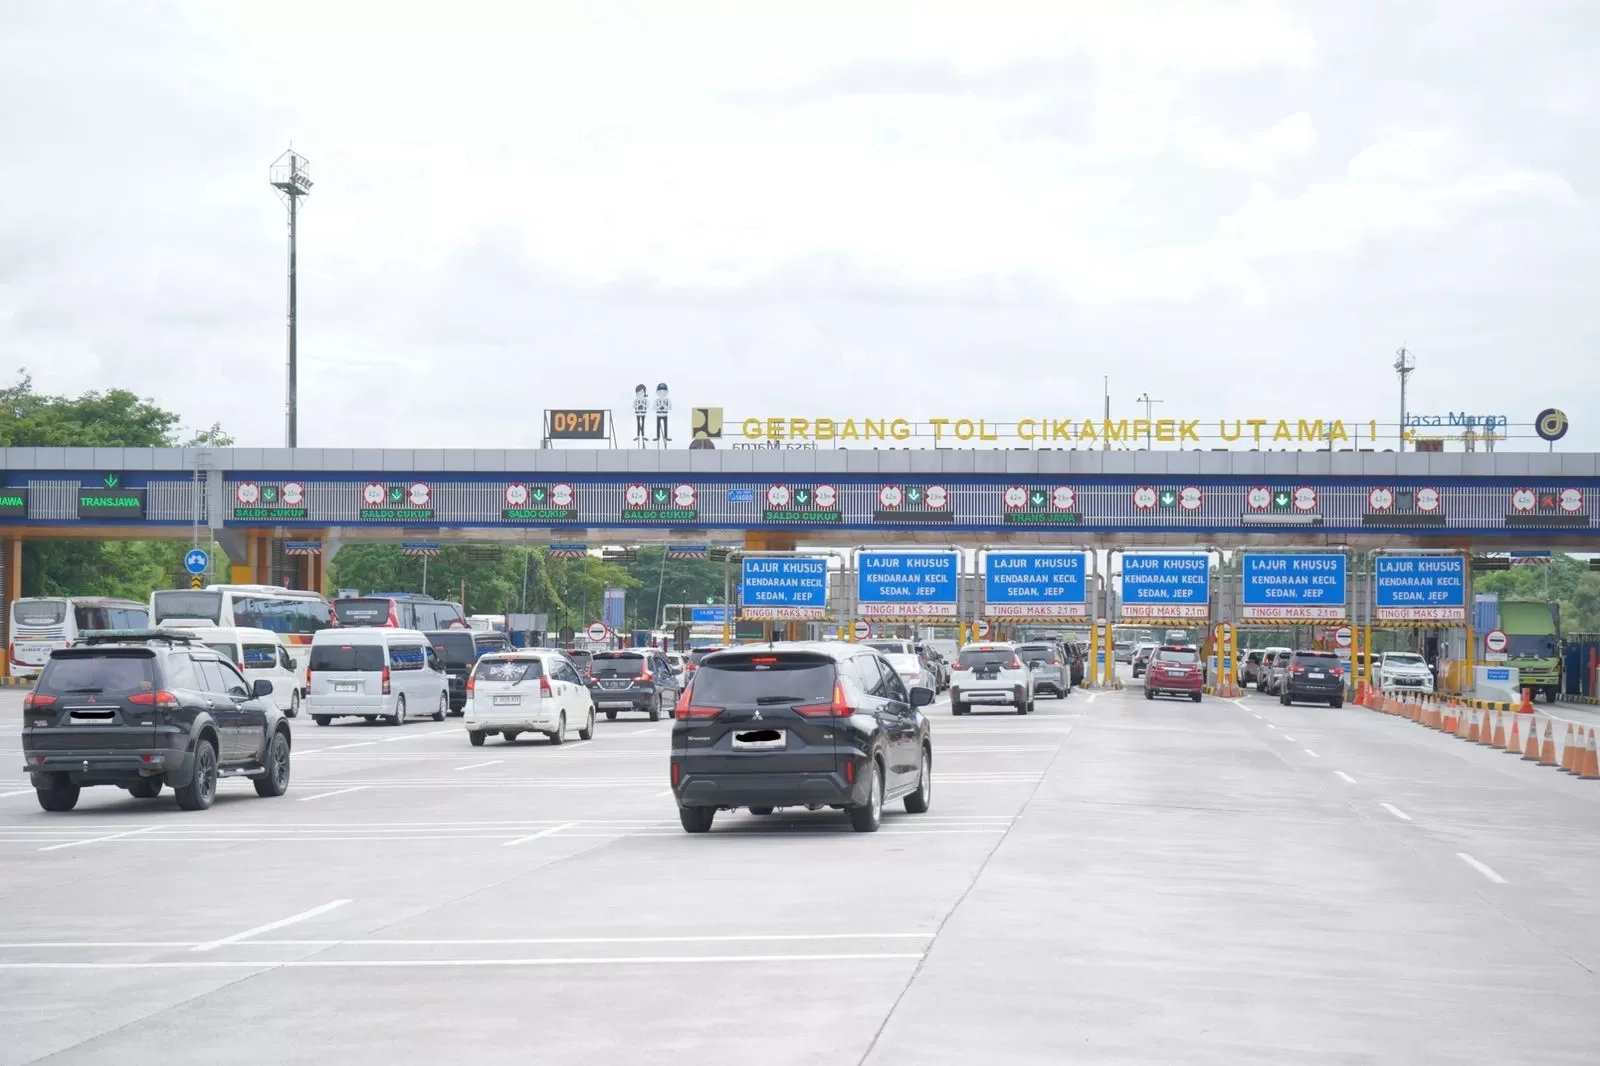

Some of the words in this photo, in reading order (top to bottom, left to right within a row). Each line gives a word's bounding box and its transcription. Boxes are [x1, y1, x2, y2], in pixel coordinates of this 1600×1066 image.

[554, 412, 601, 432] 09:17
[1404, 411, 1441, 426] Jasa
[1449, 411, 1507, 431] Marga
[742, 418, 910, 440] GERBANG
[929, 419, 998, 441] TOL
[1017, 419, 1200, 441] CIKAMPEK
[1220, 419, 1348, 441] UTAMA
[1368, 419, 1376, 441] 1
[81, 498, 140, 507] TRANSJAWA
[362, 510, 393, 518] SALDO
[397, 510, 431, 518] CUKUP
[509, 510, 536, 518] SALDO
[538, 510, 568, 518] CUKUP
[766, 512, 799, 520] SALDO
[802, 512, 838, 520] CUKUP
[1011, 514, 1045, 522] TRANS
[1048, 514, 1075, 522] JAWA
[867, 559, 899, 567] LAJUR
[907, 559, 949, 567] KHUSUS
[994, 560, 1027, 568] LAJUR
[1035, 559, 1077, 568] KHUSUS
[1126, 560, 1158, 568] LAJUR
[1164, 560, 1204, 569] KHUSUS
[1252, 560, 1287, 569] LAJUR
[1293, 560, 1337, 569] KHUSUS
[1380, 562, 1413, 572] LAJUR
[1418, 562, 1460, 571] KHUSUS
[746, 563, 778, 572] LAJUR
[783, 563, 823, 573] KHUSUS
[746, 578, 798, 586] KENDARAAN
[800, 579, 823, 587] KECIL
[994, 575, 1048, 583] KENDARAAN
[1053, 575, 1077, 583] KECIL
[1125, 575, 1178, 583] KENDARAAN
[1182, 575, 1205, 583] KECIL
[1252, 576, 1308, 584] KENDARAAN
[1312, 576, 1336, 584] KECIL
[1379, 578, 1432, 586] KENDARAAN
[1438, 578, 1461, 586] KECIL
[880, 587, 910, 596] SEDAN,
[916, 587, 936, 595] JEEP
[1008, 588, 1039, 596] SEDAN,
[1044, 588, 1064, 596] JEEP
[1138, 589, 1169, 598] SEDAN,
[1172, 589, 1194, 597] JEEP
[1265, 589, 1298, 598] SEDAN,
[1302, 589, 1324, 597] JEEP
[1393, 592, 1424, 600] SEDAN,
[1428, 592, 1448, 600] JEEP
[756, 592, 787, 601] SEDAN,
[792, 592, 813, 600] JEEP
